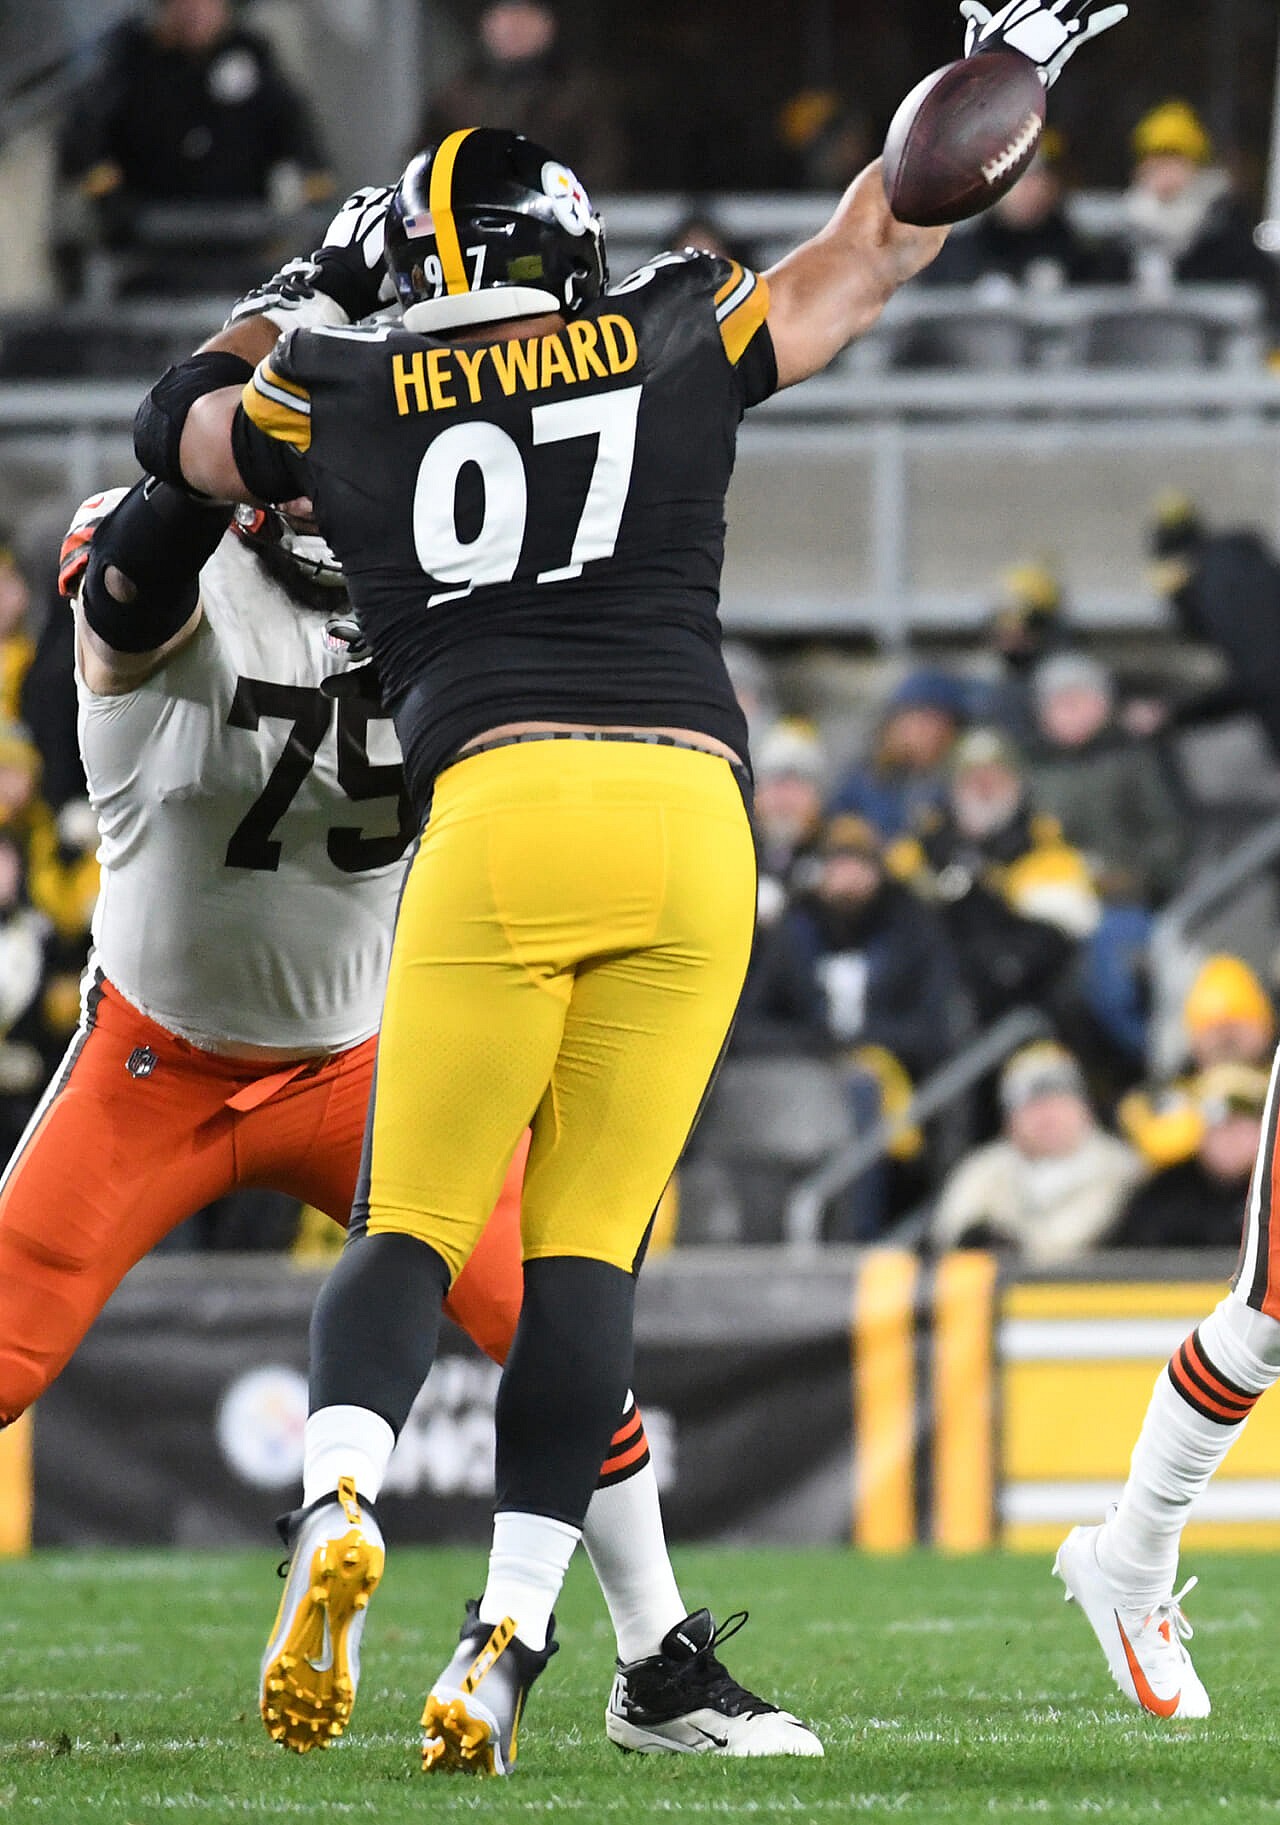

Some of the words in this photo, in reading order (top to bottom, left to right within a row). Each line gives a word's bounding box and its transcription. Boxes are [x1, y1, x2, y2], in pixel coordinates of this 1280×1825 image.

[392, 314, 639, 416] HEYWARD
[412, 383, 643, 608] 97
[224, 675, 418, 873] 75
